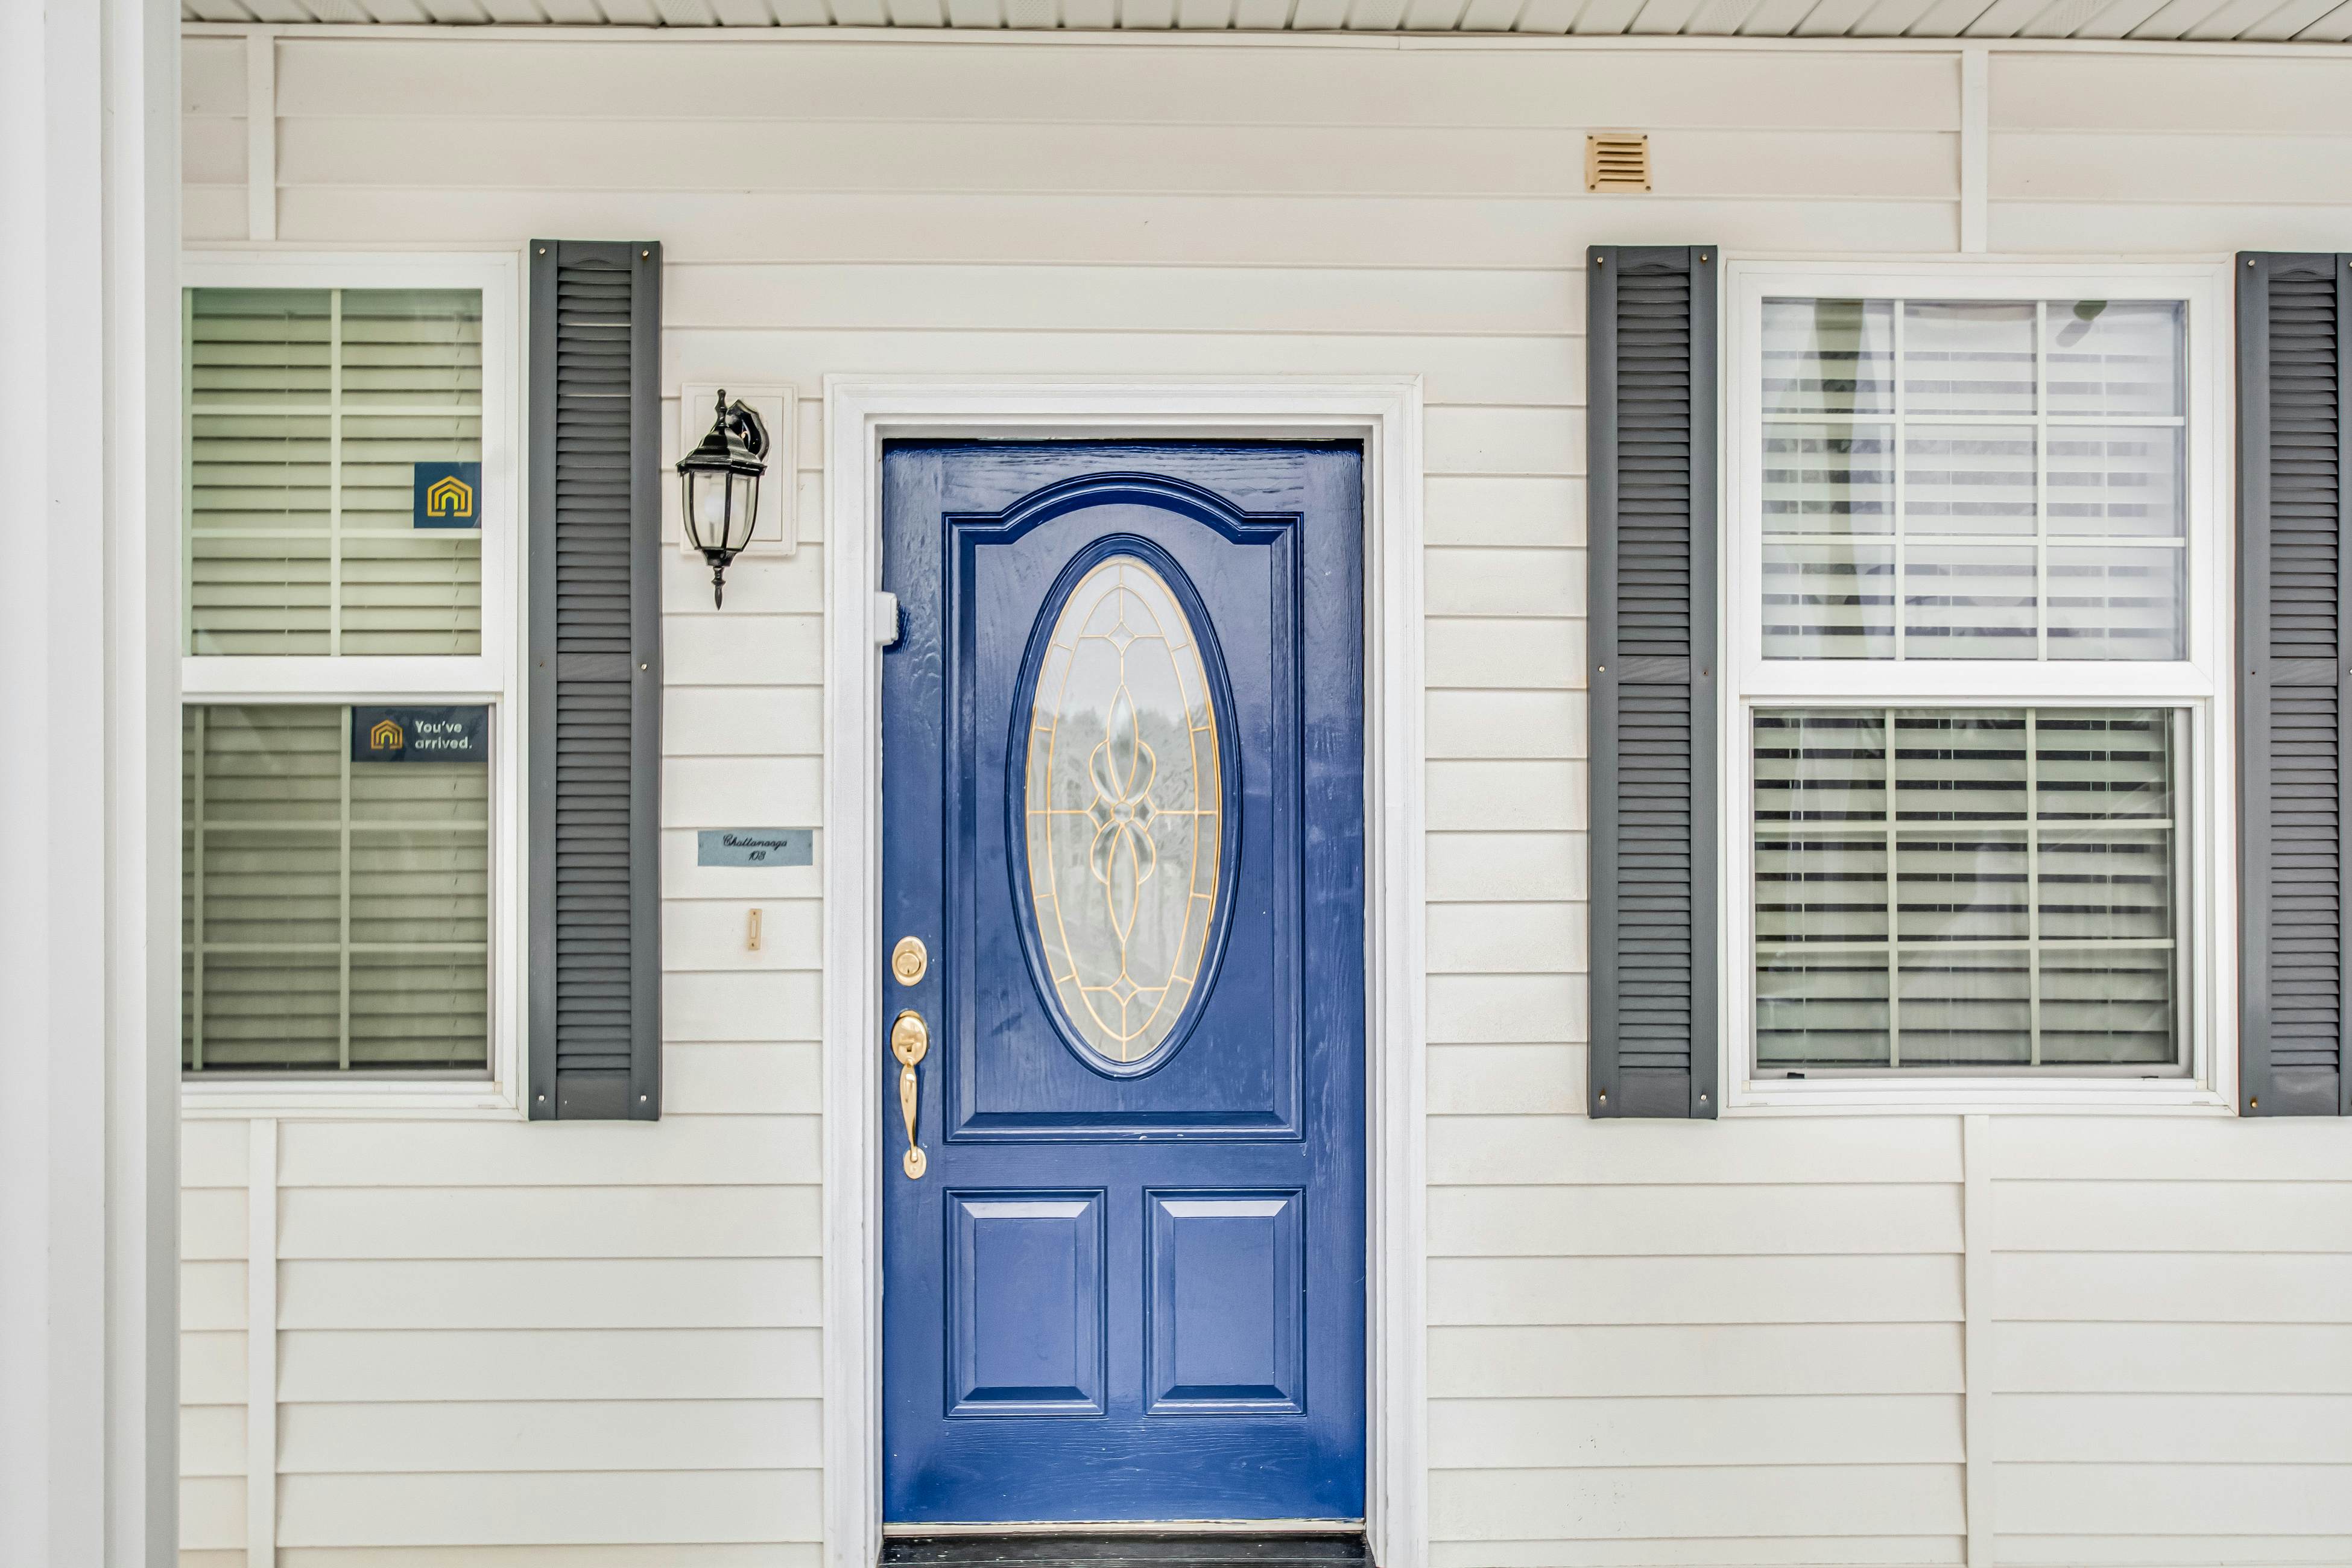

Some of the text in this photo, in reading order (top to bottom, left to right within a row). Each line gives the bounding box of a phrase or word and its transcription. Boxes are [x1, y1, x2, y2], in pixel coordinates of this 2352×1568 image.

[415, 720, 463, 733] You've
[415, 736, 472, 750] arrived.
[723, 833, 788, 851] Chattanooga
